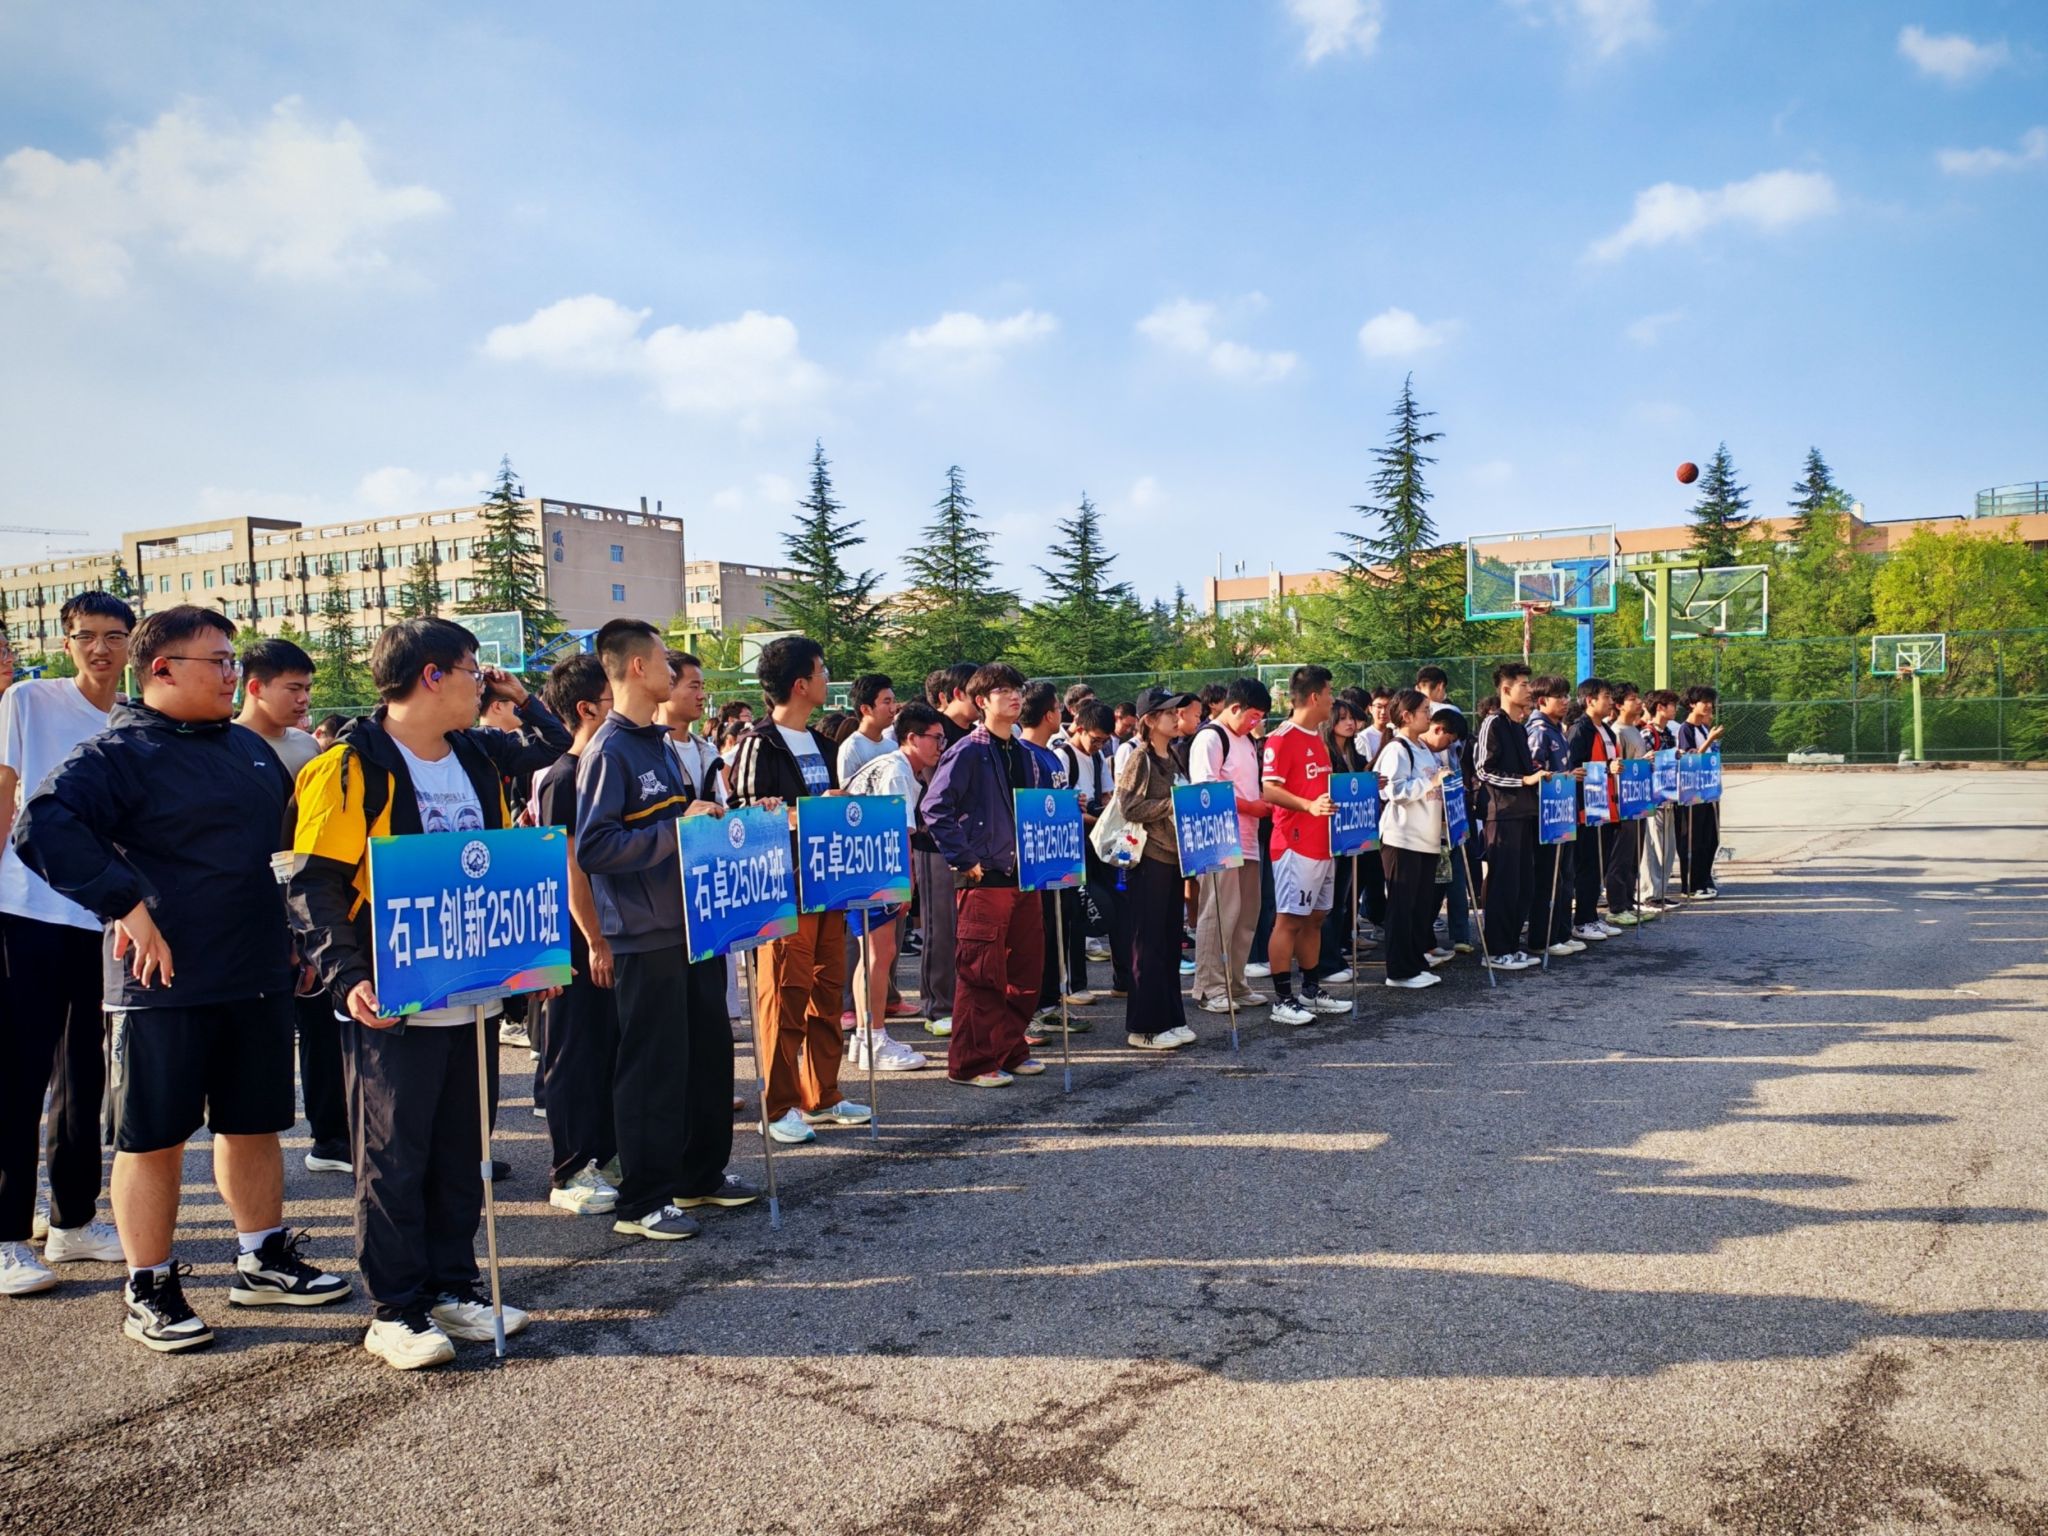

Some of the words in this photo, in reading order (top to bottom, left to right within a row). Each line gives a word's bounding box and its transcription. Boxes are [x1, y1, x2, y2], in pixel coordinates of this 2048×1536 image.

[1180, 809, 1237, 853] 海油2501班
[1334, 796, 1376, 834] 石工2506班
[809, 828, 902, 882] 石卓2501班
[1023, 821, 1080, 865] 海油2502班
[692, 845, 786, 923] 石卓2502班
[1298, 889, 1312, 907] 14
[388, 876, 561, 969] 石工创新2501班
